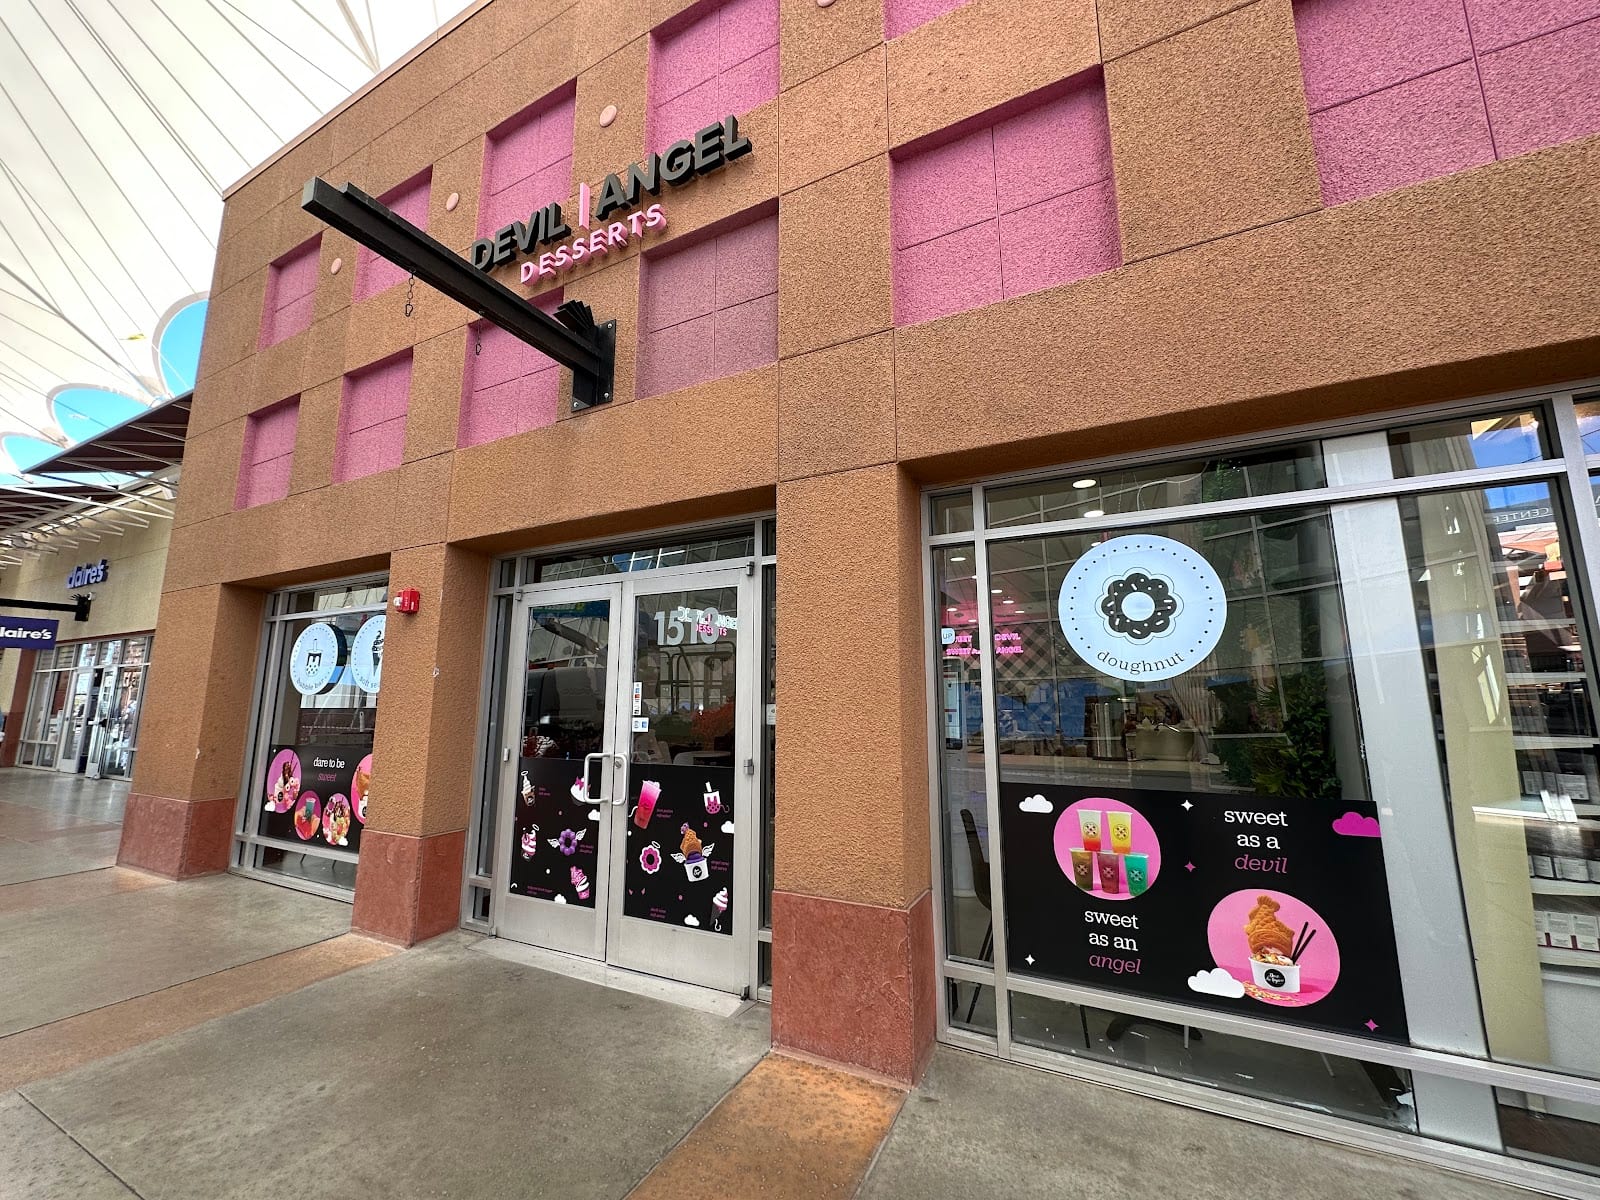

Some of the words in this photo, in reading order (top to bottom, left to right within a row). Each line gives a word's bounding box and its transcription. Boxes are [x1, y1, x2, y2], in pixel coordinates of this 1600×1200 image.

[470, 202, 571, 272] DEVIL
[595, 114, 752, 221] ANGEL
[520, 203, 667, 286] DESSERTS
[0, 627, 52, 640] laire's
[1097, 649, 1186, 676] doughnut
[313, 756, 328, 768] dare
[328, 758, 336, 769] to
[336, 757, 345, 770] be
[1224, 807, 1288, 827] sweet
[1236, 833, 1261, 848] as
[1265, 836, 1281, 850] a
[1233, 853, 1288, 875] devil
[1084, 908, 1140, 930] sweet
[1088, 931, 1109, 947] as
[1113, 934, 1138, 951] an
[1088, 953, 1141, 975] angel
